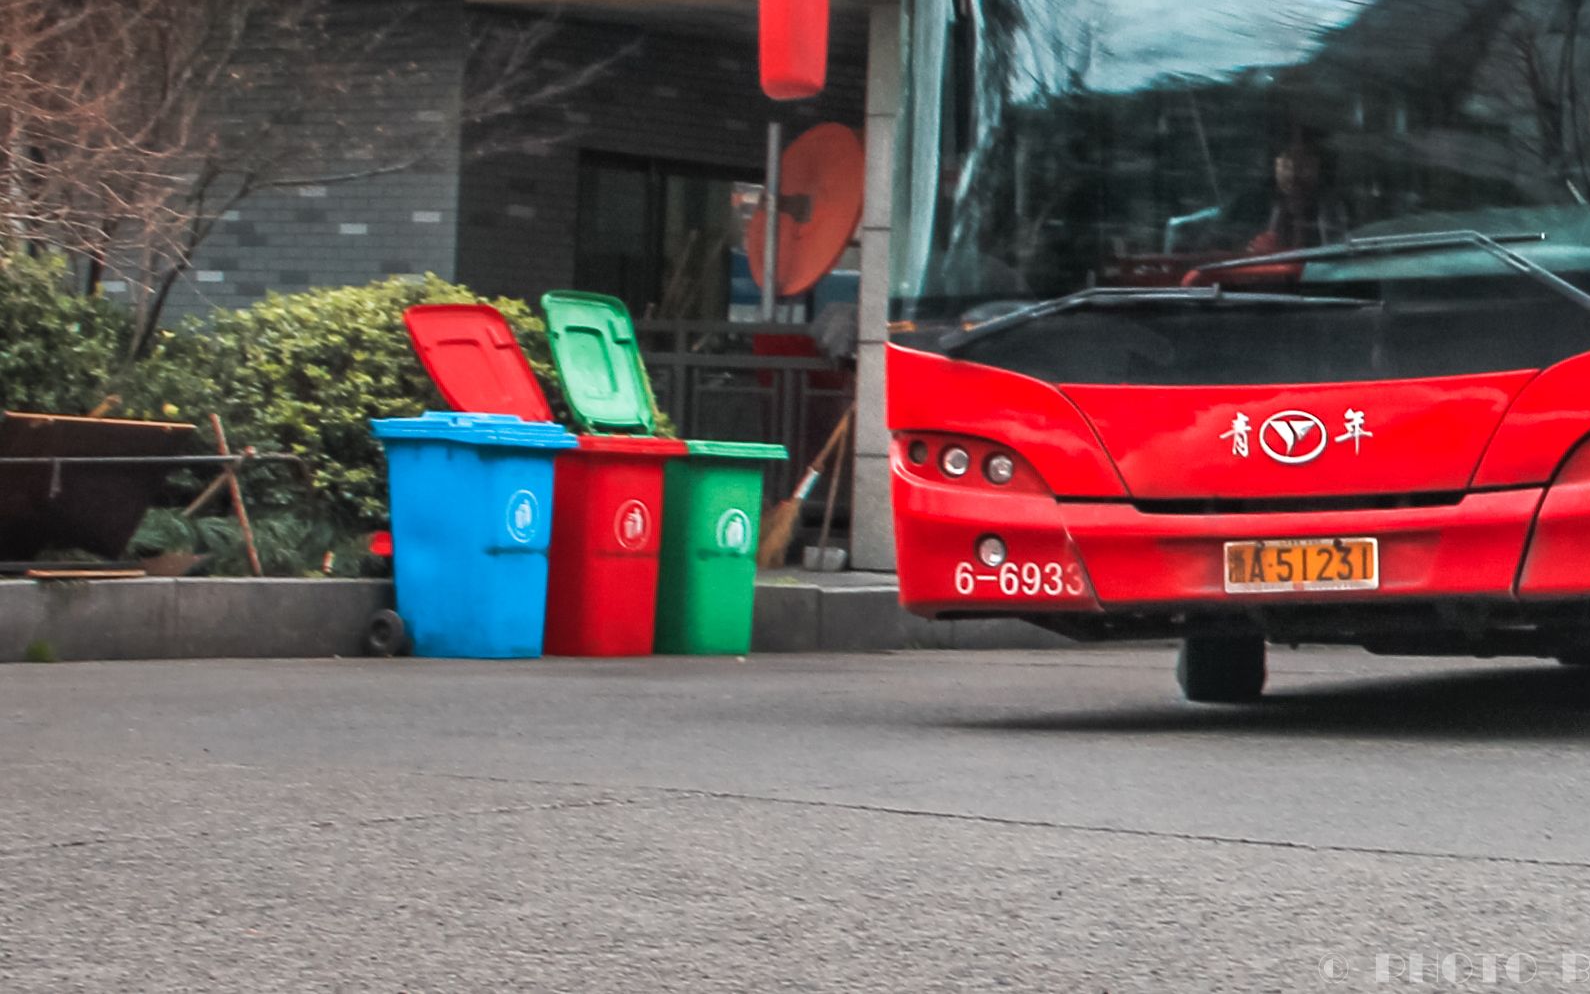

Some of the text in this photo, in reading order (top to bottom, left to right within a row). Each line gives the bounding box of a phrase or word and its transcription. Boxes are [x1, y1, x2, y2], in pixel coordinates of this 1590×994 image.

[1220, 409, 1374, 457] 青 年
[955, 561, 1086, 596] 6-6933
